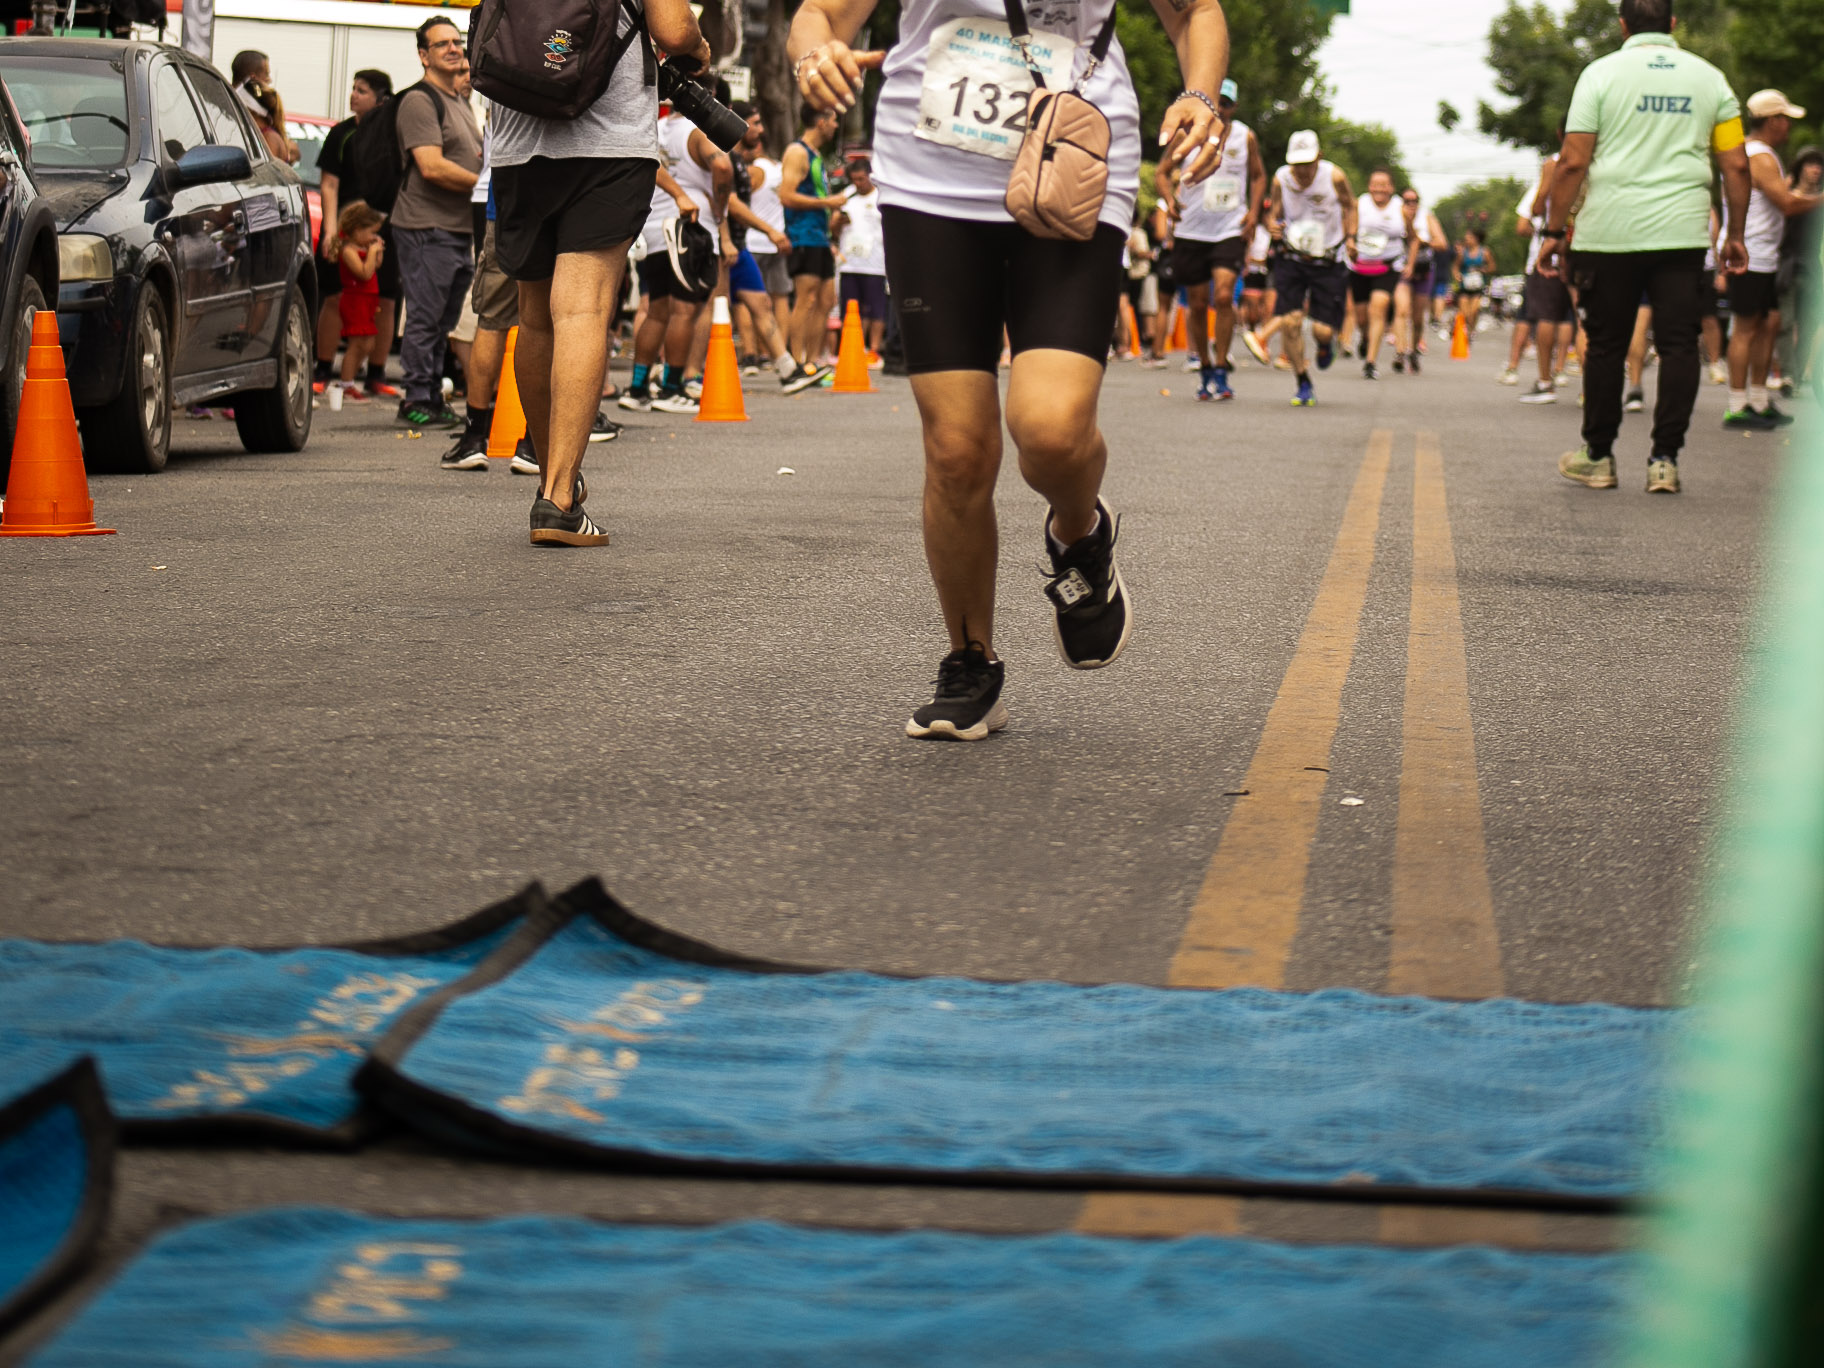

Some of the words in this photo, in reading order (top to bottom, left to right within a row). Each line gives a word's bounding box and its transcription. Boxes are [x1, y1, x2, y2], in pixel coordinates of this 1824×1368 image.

[948, 42, 996, 60] EMPALME
[956, 28, 975, 39] 40
[978, 32, 1053, 59] MARAON
[949, 76, 1031, 133] 132
[1636, 95, 1692, 114] JUEZ
[1063, 584, 1076, 598] 132
